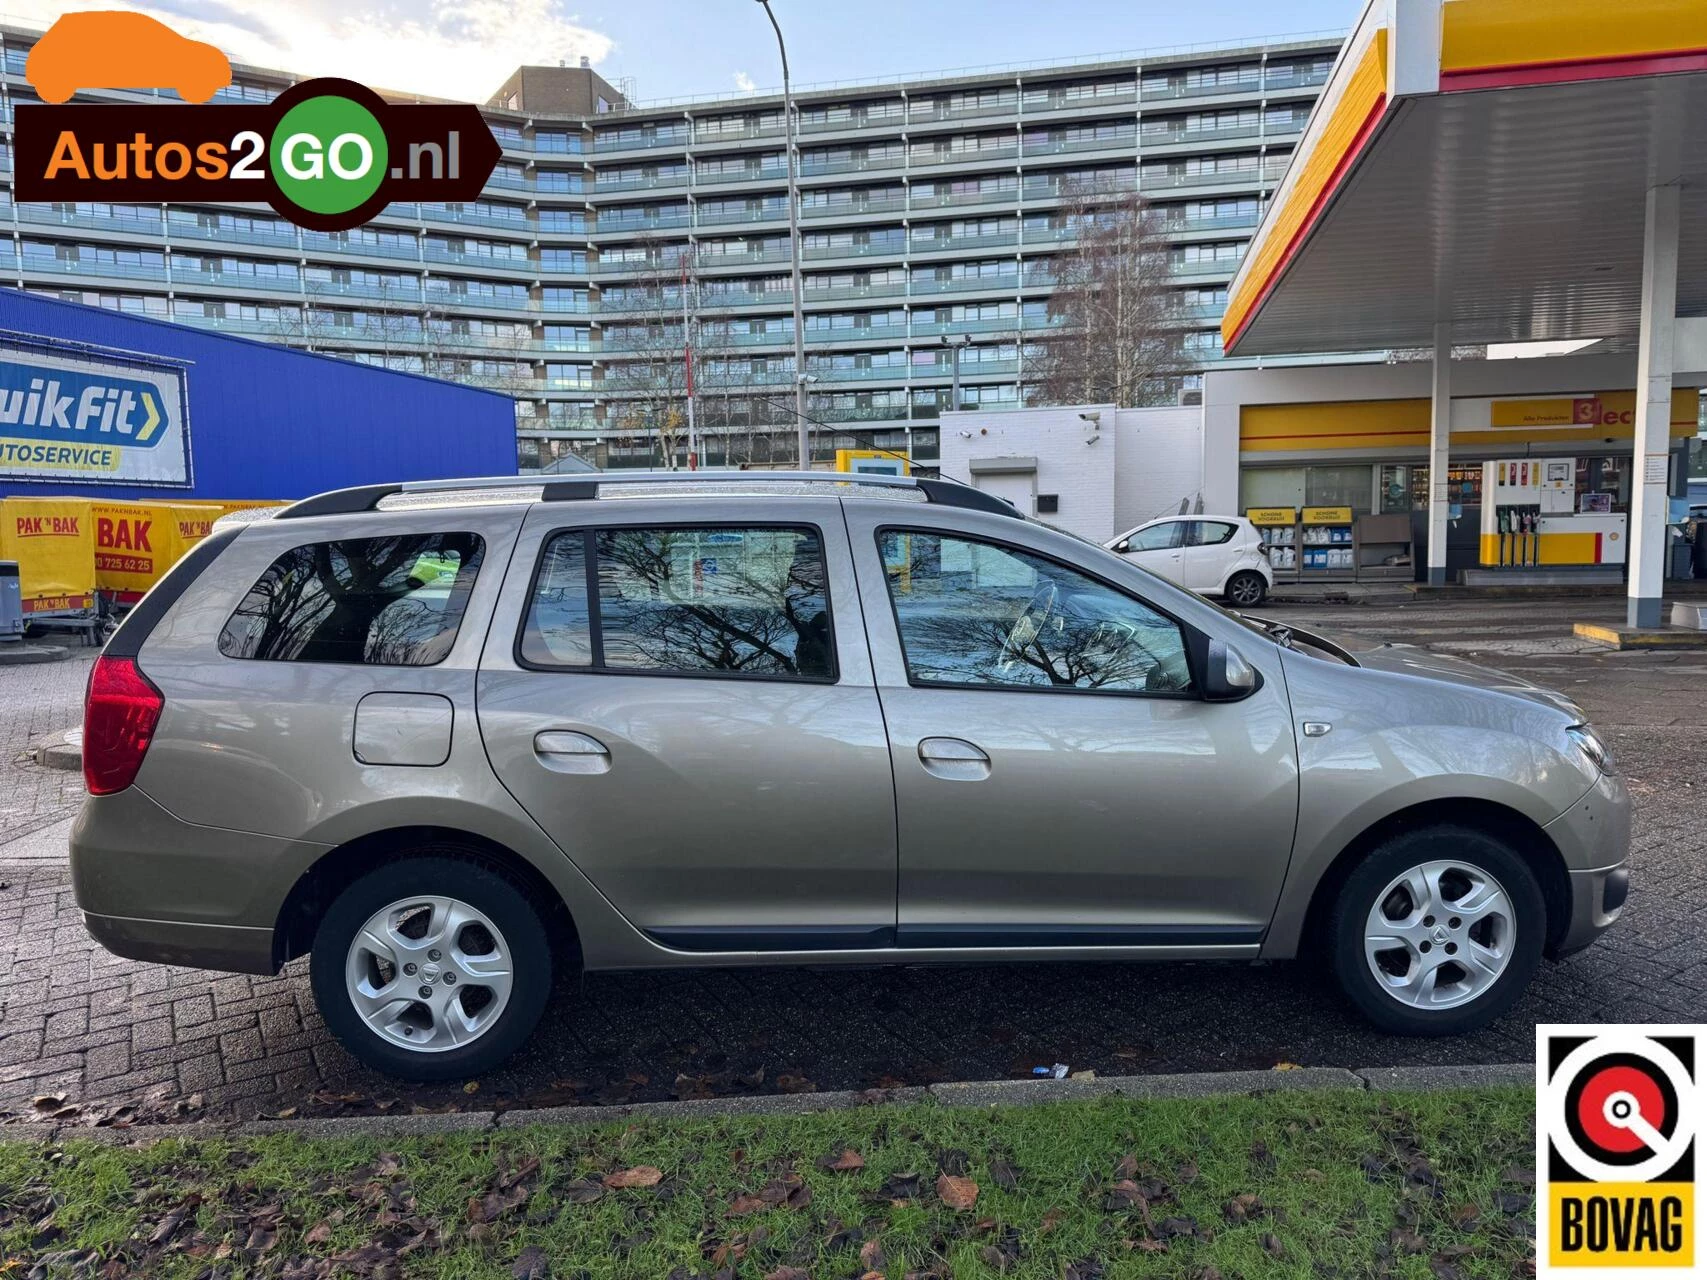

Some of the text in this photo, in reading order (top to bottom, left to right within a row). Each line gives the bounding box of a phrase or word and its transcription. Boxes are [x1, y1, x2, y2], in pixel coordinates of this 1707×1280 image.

[0, 443, 112, 466] TOSERVICE
[16, 517, 42, 534] PAK
[52, 517, 79, 533] BAK
[179, 521, 195, 537] PAK
[200, 520, 213, 535] BA
[98, 518, 152, 552] BAK
[105, 557, 122, 570] 725
[124, 559, 136, 570] 62
[138, 560, 150, 571] 25
[33, 600, 49, 610] PAK
[54, 599, 70, 609] BAK
